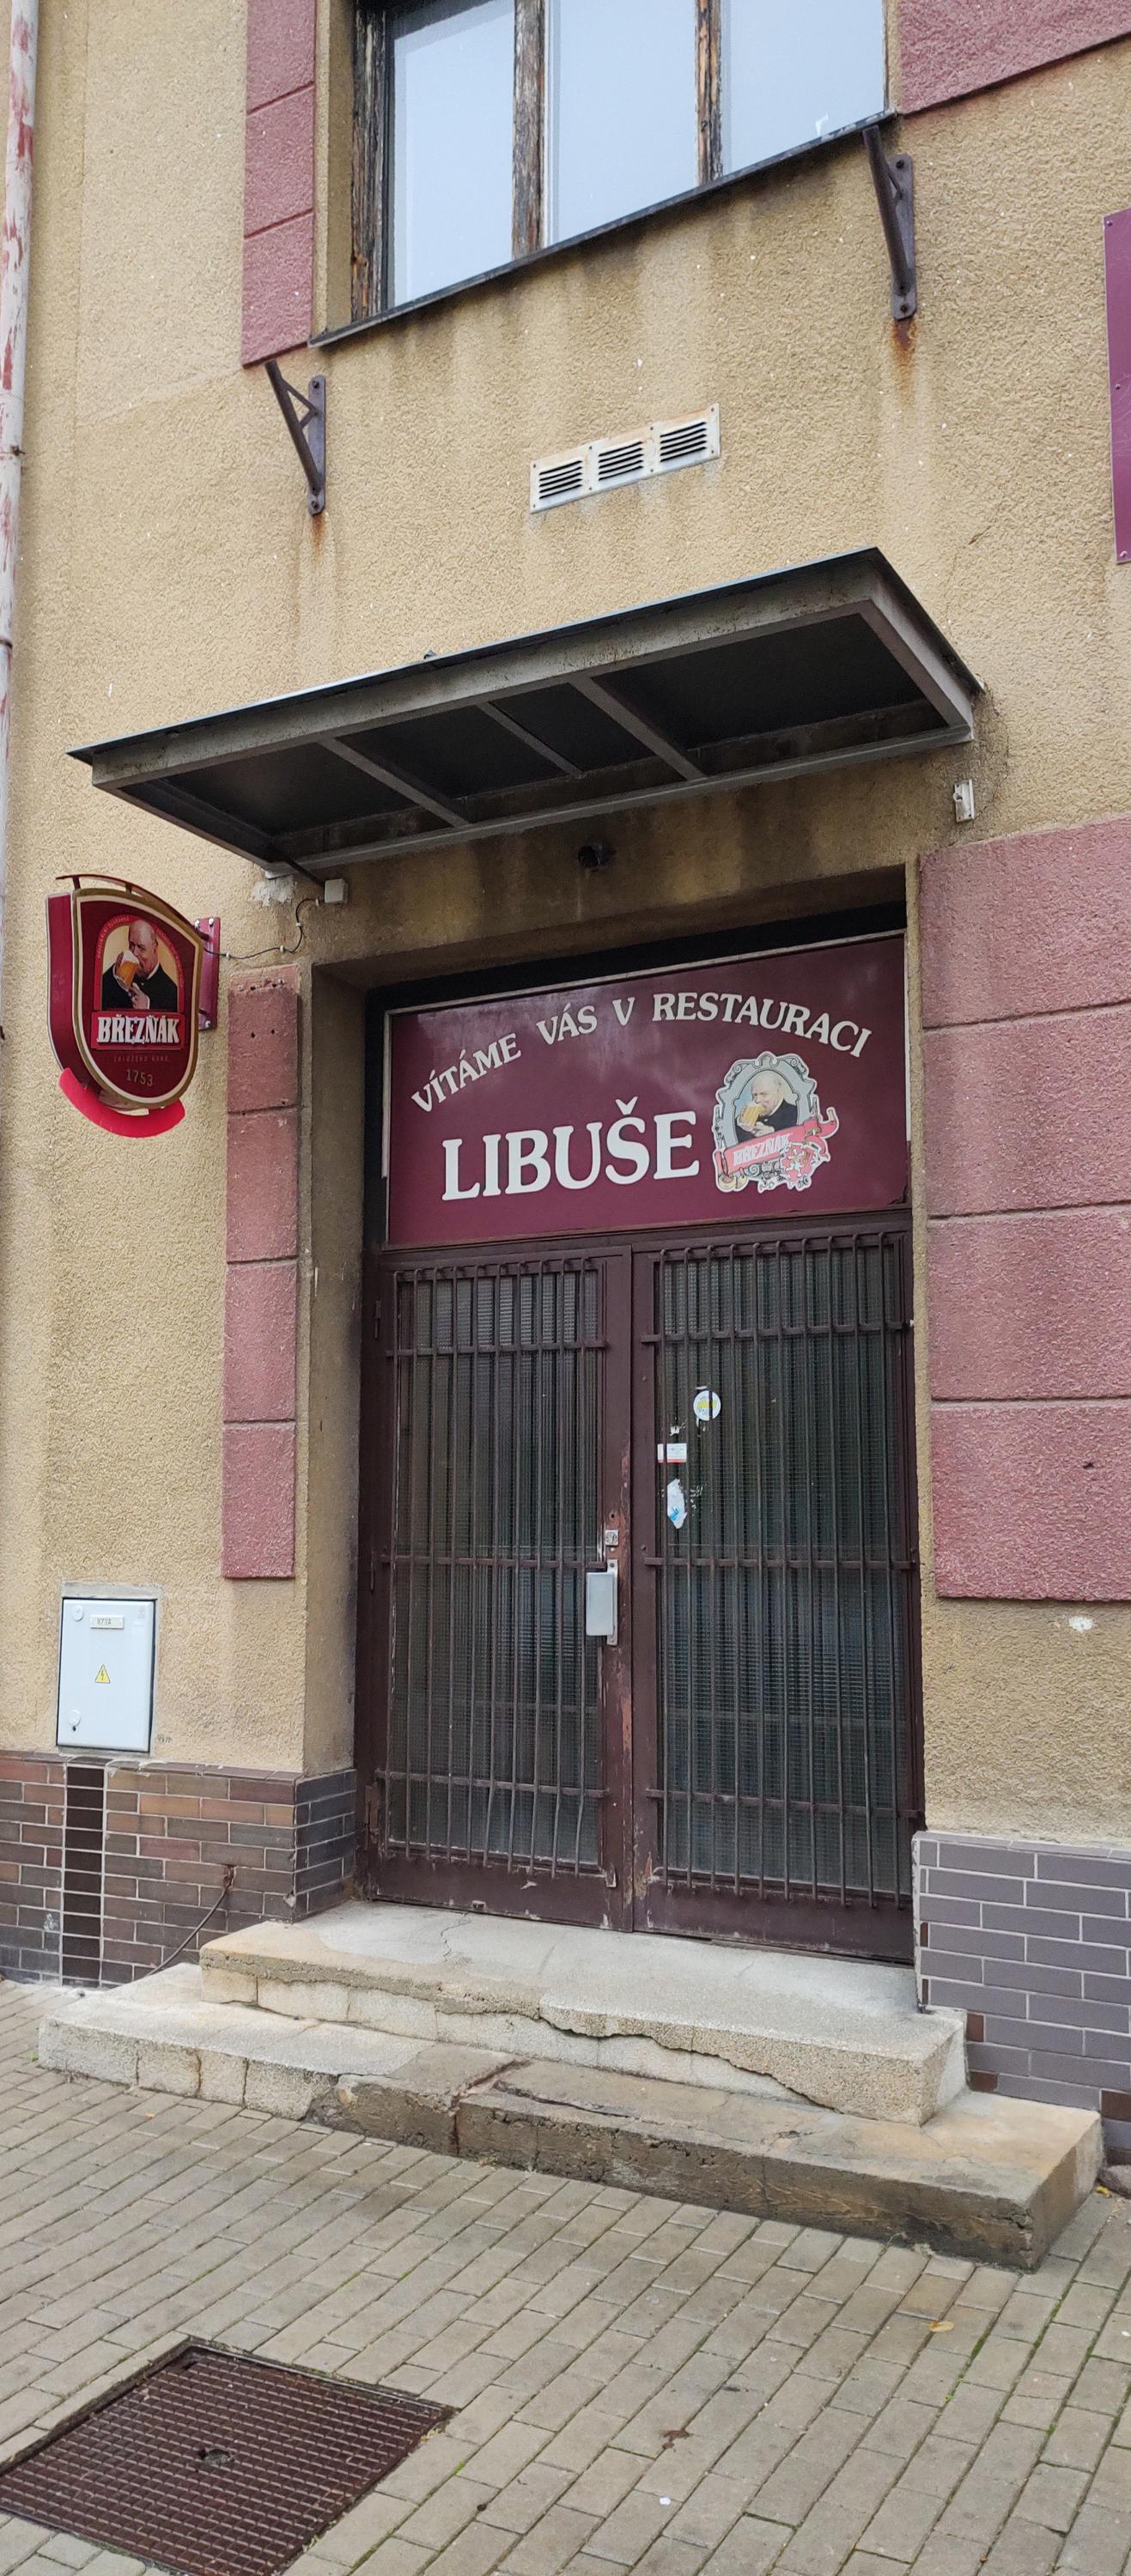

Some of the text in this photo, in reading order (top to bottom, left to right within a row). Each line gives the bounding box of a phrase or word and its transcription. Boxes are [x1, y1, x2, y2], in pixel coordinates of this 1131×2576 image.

[96, 1014, 179, 1044] BŘEZŇÁK
[410, 992, 873, 1113] VÍTÁME VÁS V RESTAURACI
[126, 1067, 154, 1087] 1753
[441, 1096, 700, 1201] LIBUŠE
